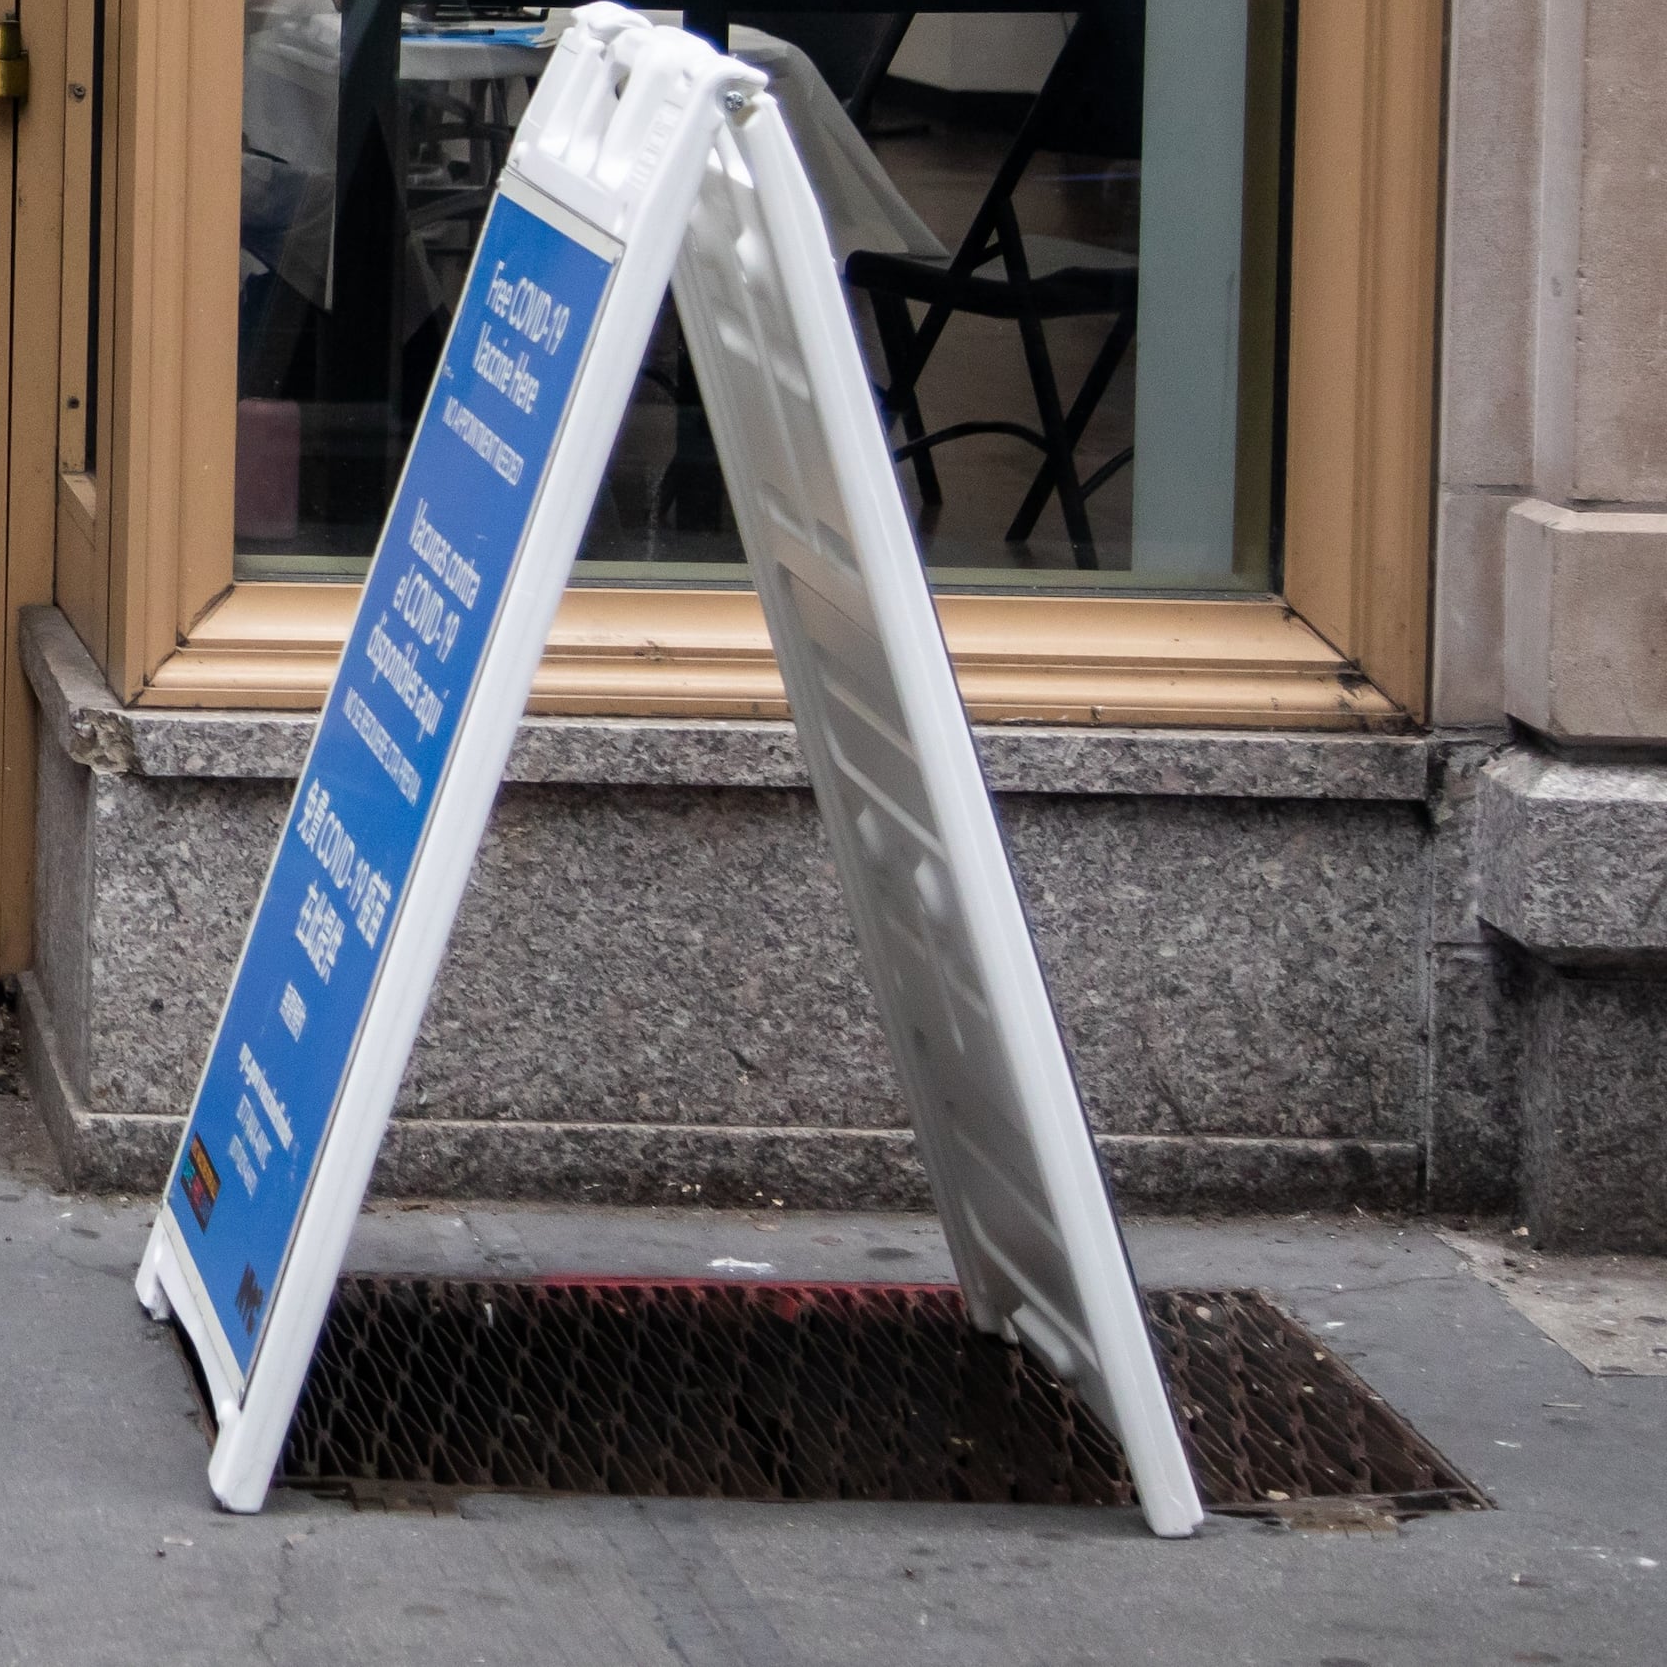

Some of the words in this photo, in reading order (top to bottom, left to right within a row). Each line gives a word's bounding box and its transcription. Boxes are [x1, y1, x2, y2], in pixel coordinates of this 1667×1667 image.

[485, 259, 514, 319] Free
[507, 276, 570, 356] COVID-19
[472, 320, 514, 395] Vaccine
[507, 351, 540, 415] Here
